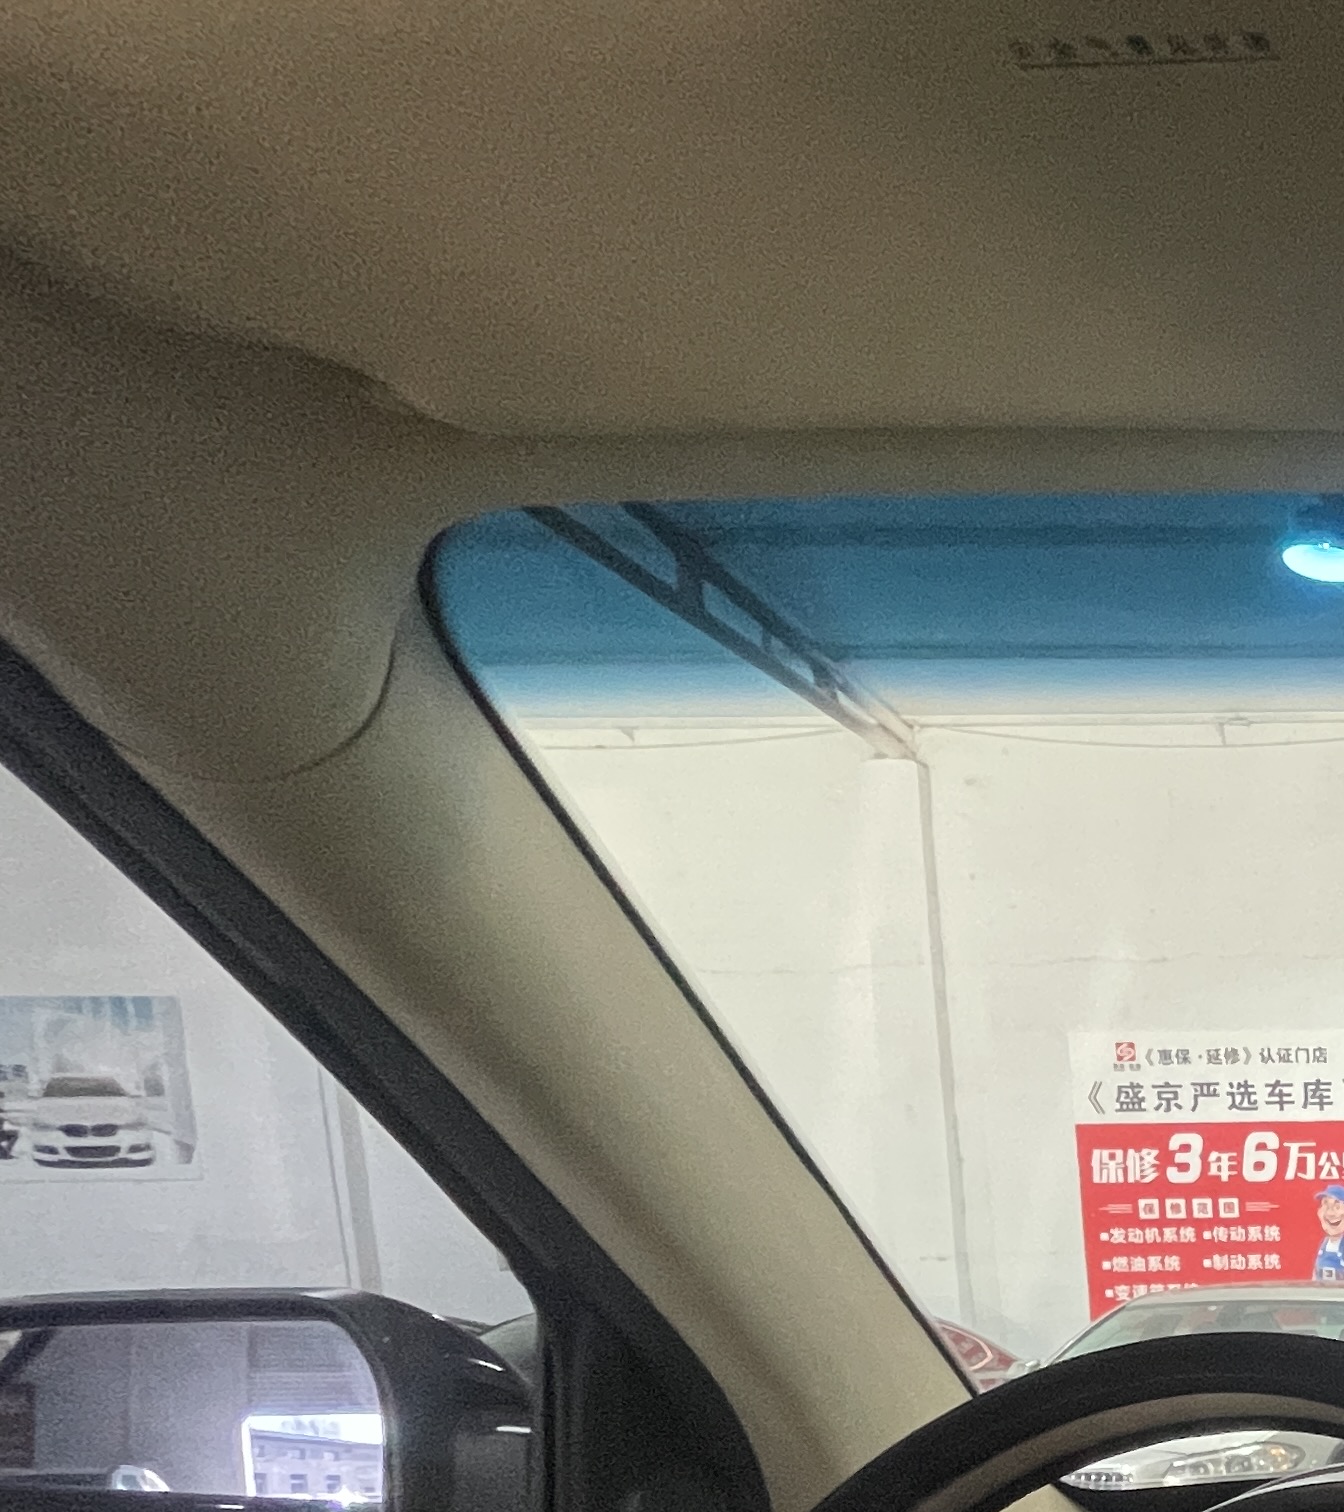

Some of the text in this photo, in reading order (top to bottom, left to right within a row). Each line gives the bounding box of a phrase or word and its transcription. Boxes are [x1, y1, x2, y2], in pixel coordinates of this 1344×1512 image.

[1109, 1225, 1281, 1244] 发动机系统 传动系统
[1112, 1253, 1281, 1273] 燃油系统 制动系统
